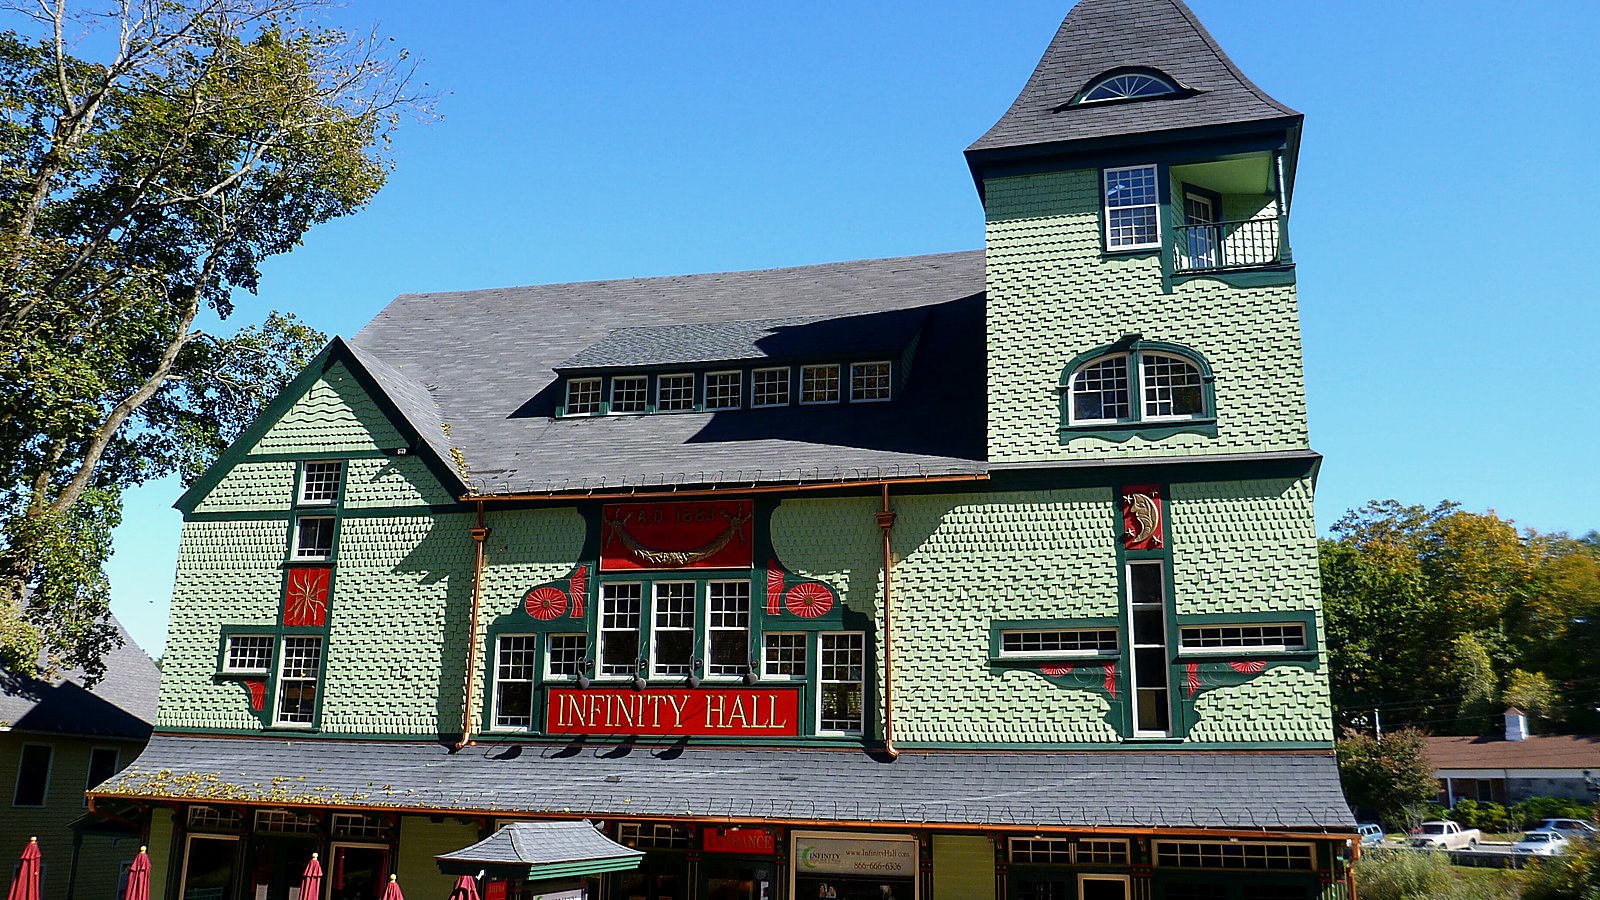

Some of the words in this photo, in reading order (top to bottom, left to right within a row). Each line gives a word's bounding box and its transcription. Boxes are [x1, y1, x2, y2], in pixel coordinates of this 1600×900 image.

[557, 694, 691, 727] INFINITY
[705, 695, 787, 728] HALL
[709, 835, 771, 849] ENTRANCE
[846, 848, 910, 858] www.InfinityHall.com
